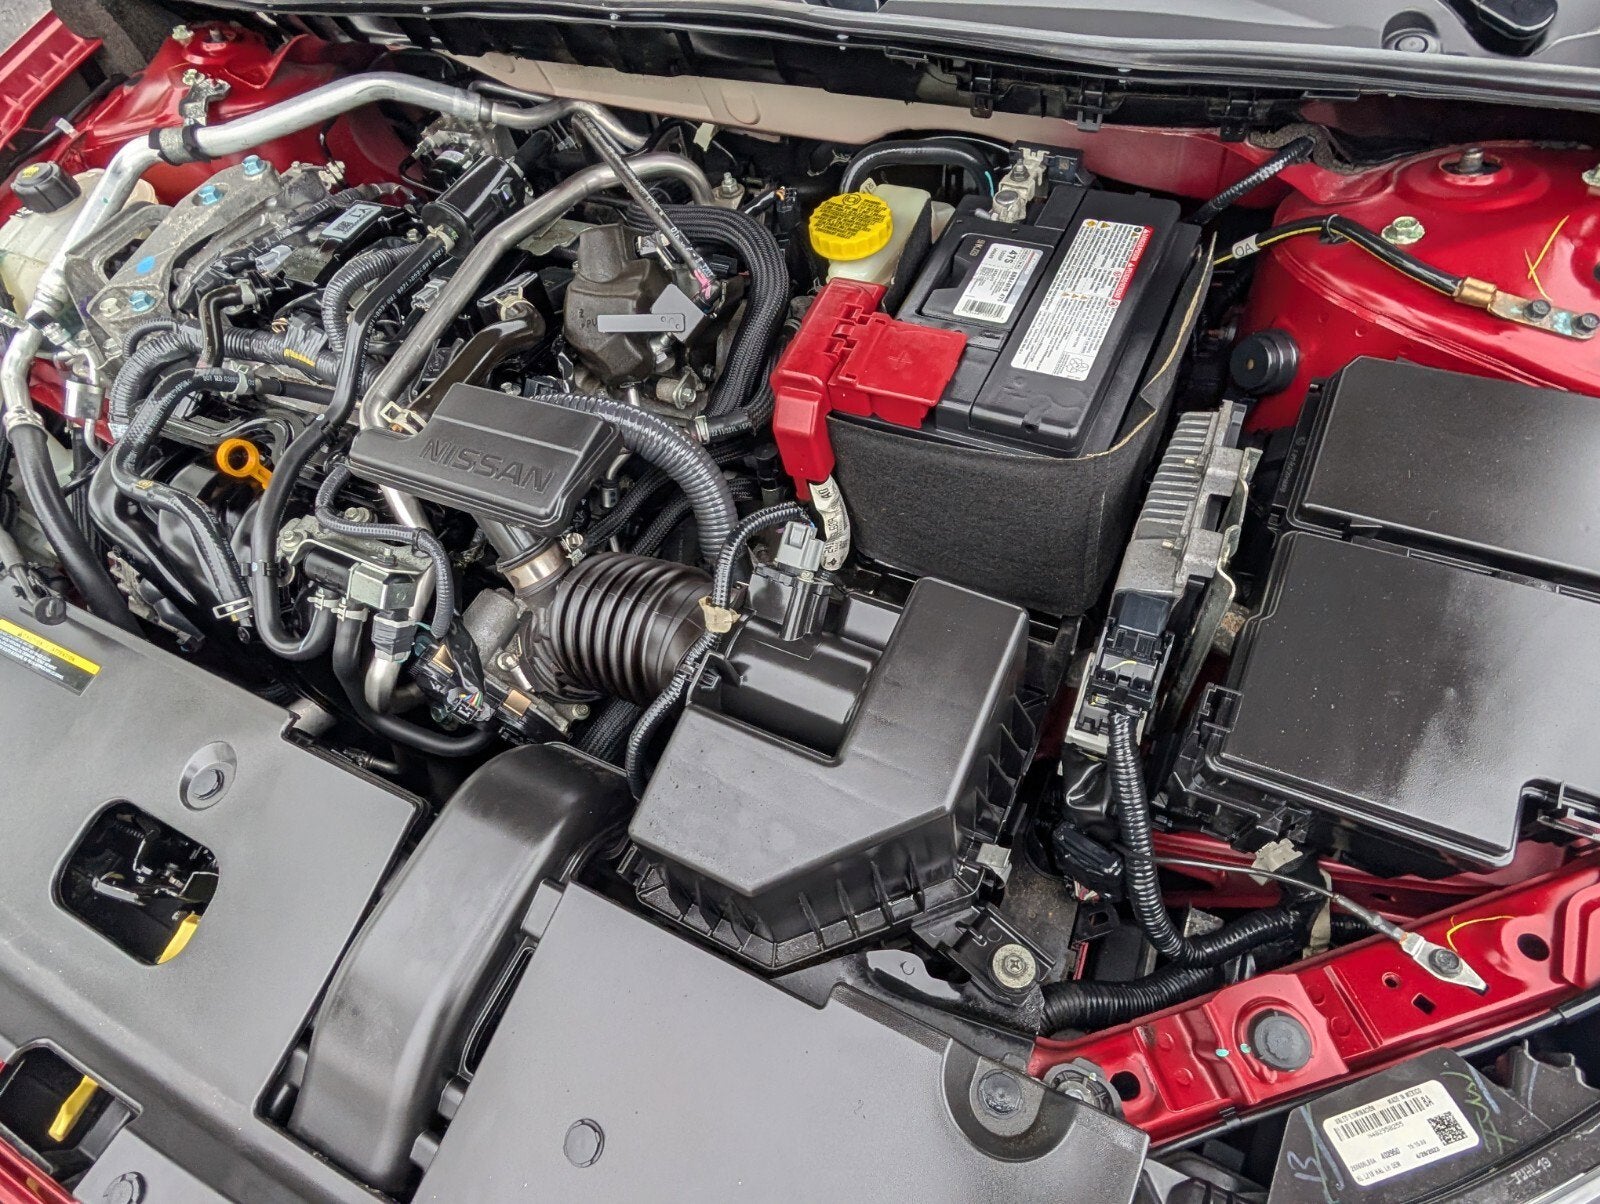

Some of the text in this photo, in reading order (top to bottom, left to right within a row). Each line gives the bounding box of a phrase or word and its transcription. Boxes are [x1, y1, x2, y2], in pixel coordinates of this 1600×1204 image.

[1235, 242, 1254, 256] OA
[1004, 250, 1018, 263] 47S
[419, 438, 556, 494] NISSAN
